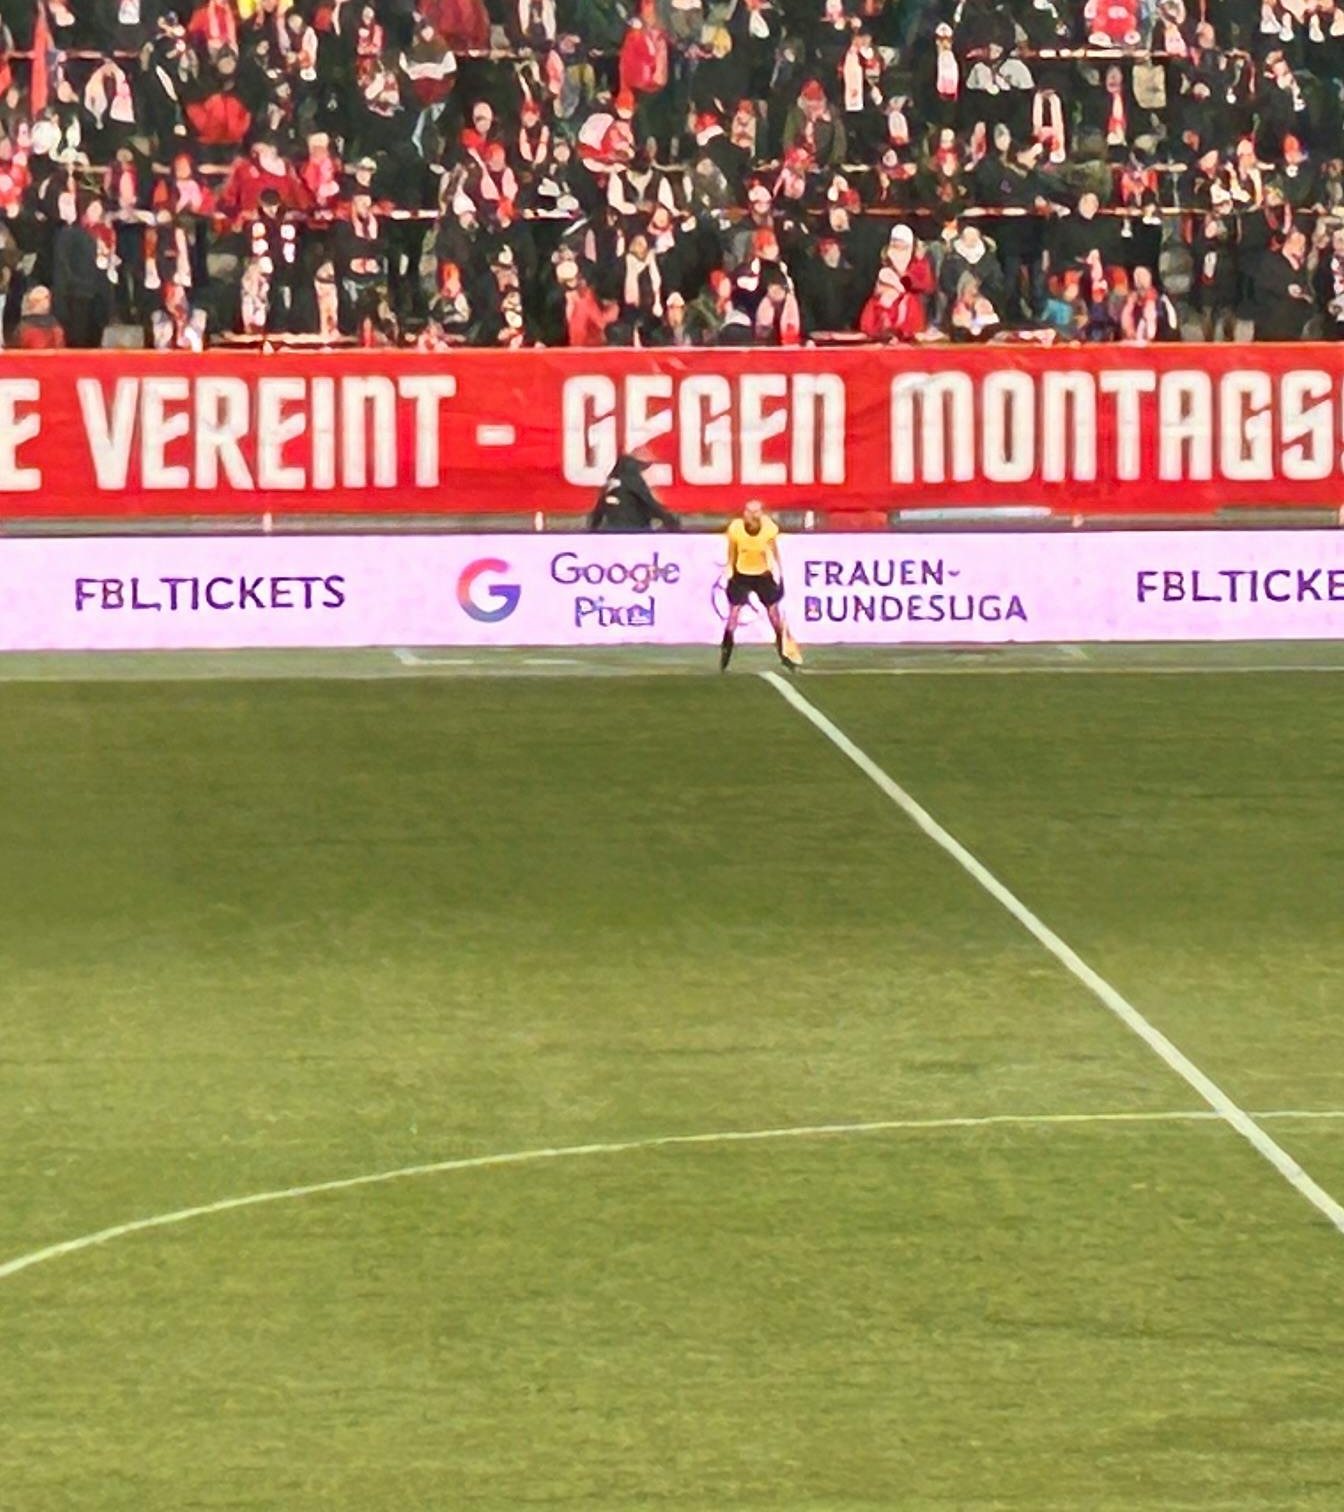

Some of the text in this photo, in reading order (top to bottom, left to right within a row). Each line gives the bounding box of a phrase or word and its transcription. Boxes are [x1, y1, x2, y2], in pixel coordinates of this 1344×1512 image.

[76, 375, 457, 491] VEREINT
[561, 372, 846, 487] GEGEN
[550, 551, 681, 594] Google
[803, 558, 962, 588] FRAUEN-
[803, 593, 1029, 623] BUNDESLIGA
